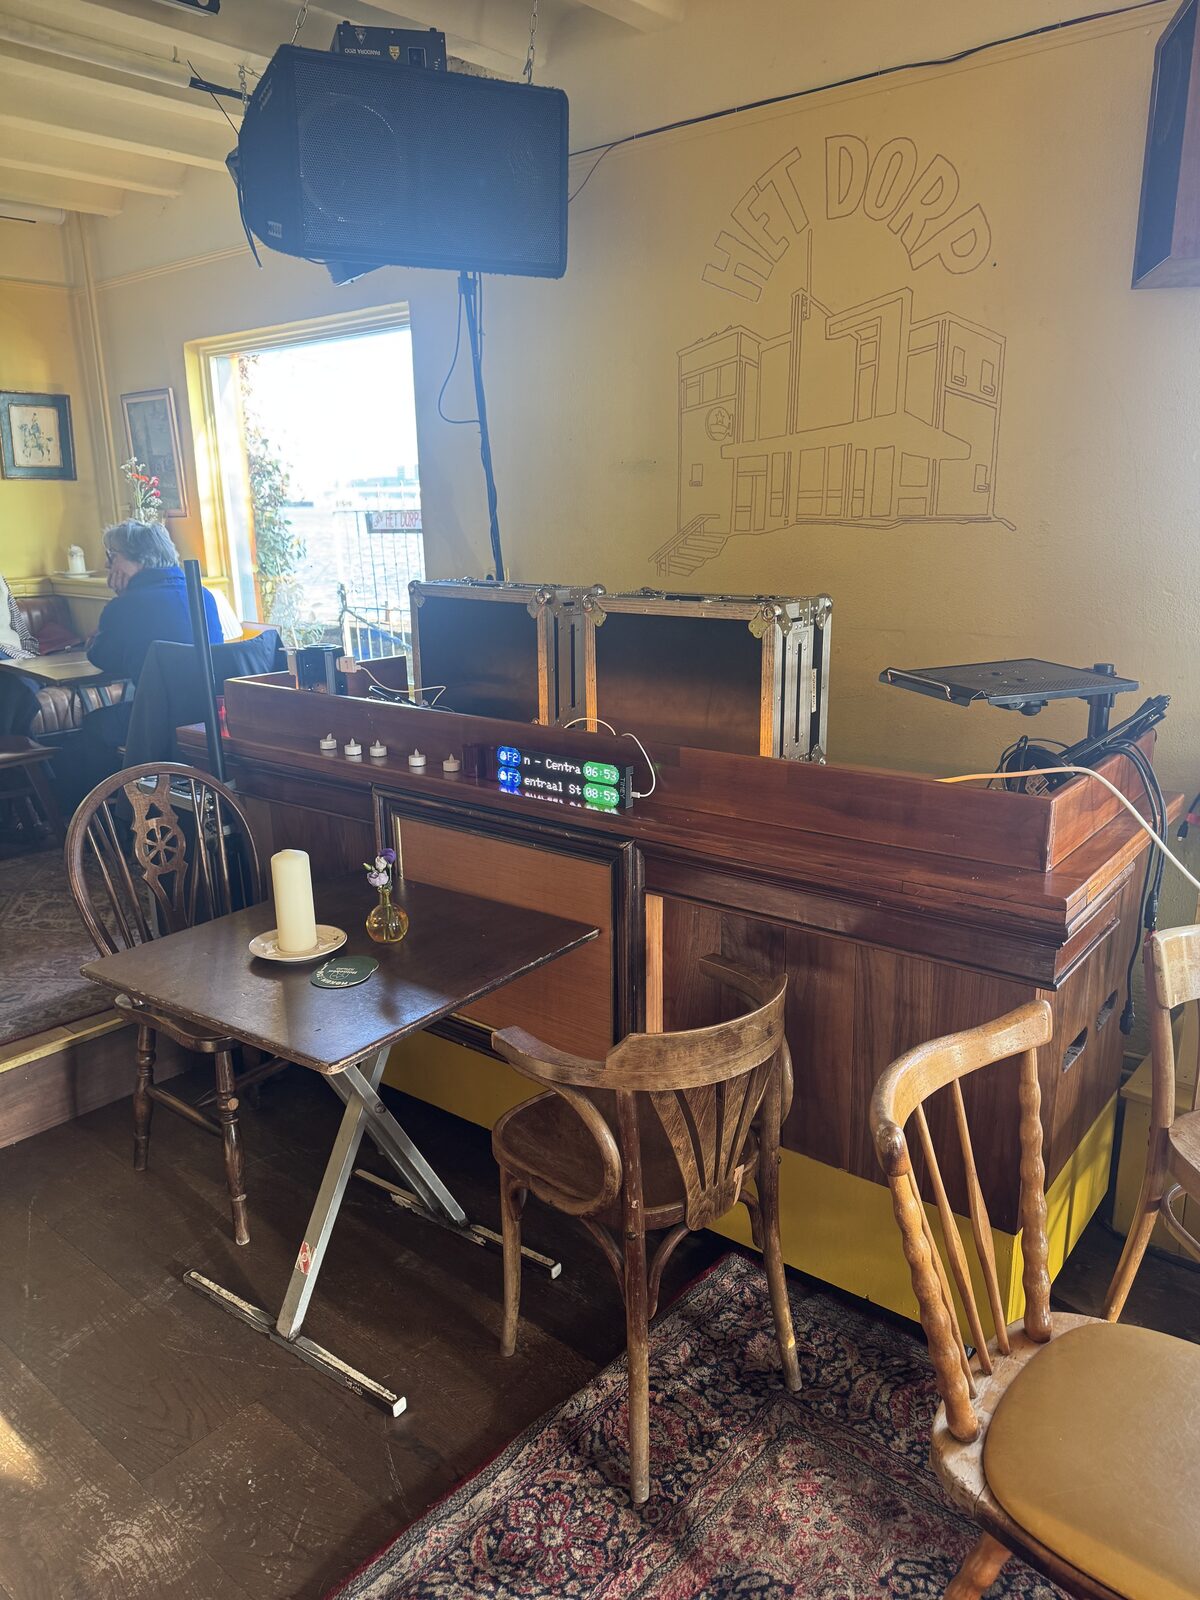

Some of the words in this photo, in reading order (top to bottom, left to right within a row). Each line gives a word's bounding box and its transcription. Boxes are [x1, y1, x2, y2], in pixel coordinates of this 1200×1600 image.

[357, 48, 381, 56] PANDORA
[701, 146, 809, 303] HET
[825, 134, 991, 275] DORP
[506, 751, 519, 763] F2
[545, 758, 582, 775] Centra
[585, 765, 617, 781] 06:53
[506, 771, 519, 783] F3
[523, 776, 563, 793] entraal
[568, 784, 582, 796] St
[585, 787, 617, 804] 08:53
